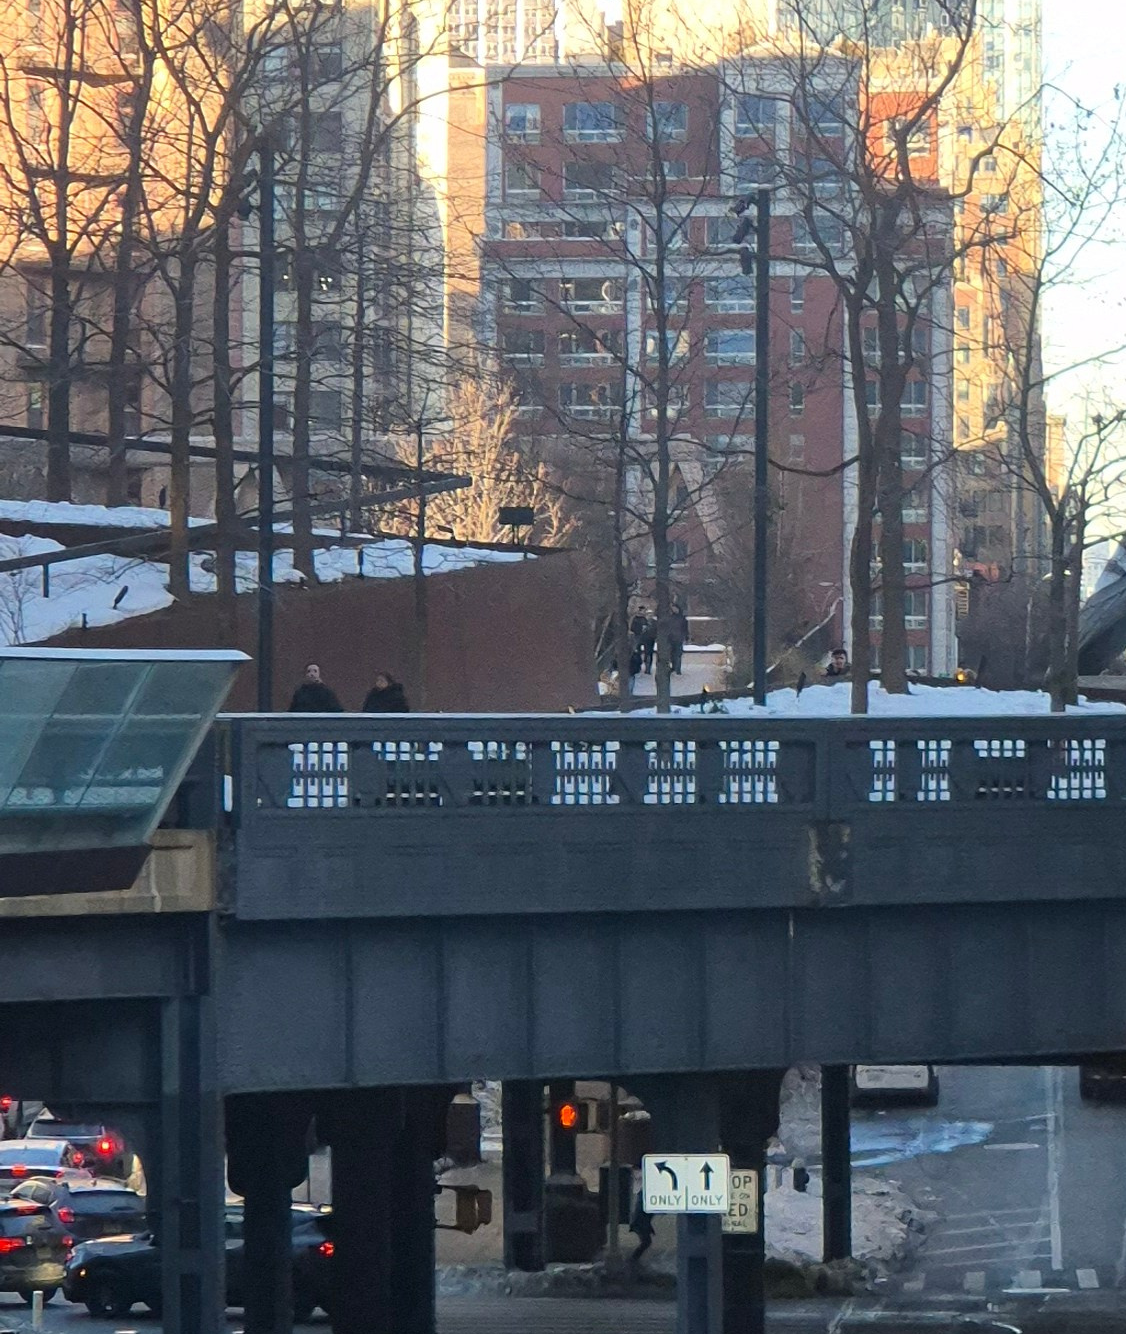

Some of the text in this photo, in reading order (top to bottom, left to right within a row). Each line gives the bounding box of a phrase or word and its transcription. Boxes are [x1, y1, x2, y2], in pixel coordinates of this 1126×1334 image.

[731, 1175, 752, 1189] OP
[649, 1195, 682, 1206] ONLY
[691, 1195, 724, 1206] ONLY
[727, 1203, 748, 1217] ED
